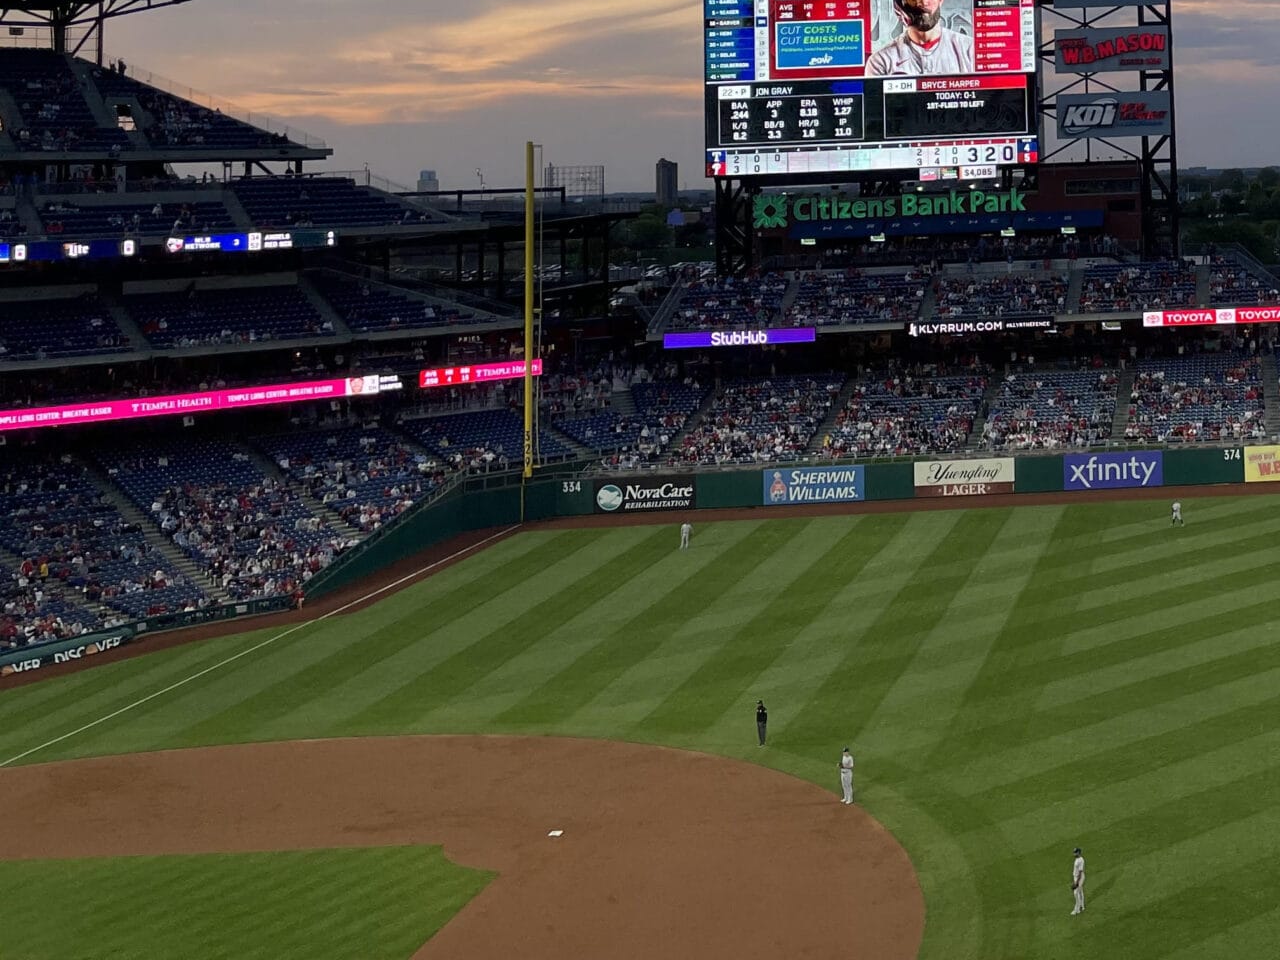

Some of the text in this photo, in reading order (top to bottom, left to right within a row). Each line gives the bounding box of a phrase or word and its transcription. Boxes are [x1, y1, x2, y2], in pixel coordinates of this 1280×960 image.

[780, 25, 837, 35] CUT COSTS
[780, 35, 860, 45] CUT EMISSIONS
[1062, 33, 1166, 65] W.B.MASON
[887, 81, 913, 90] 3 DH
[922, 79, 980, 90] BRYCE HARPER
[722, 89, 733, 97] 22
[756, 86, 793, 97] JON GRAY
[935, 91, 976, 100] TODAY: 0-1
[731, 98, 853, 110] BAA APP ERA WHIP
[959, 101, 968, 109] TO
[968, 100, 984, 108] LEFT
[730, 111, 749, 119] .244
[771, 110, 778, 118] 3
[834, 107, 852, 116] 1.27
[732, 122, 747, 130] K/9
[764, 120, 784, 129] BB/9
[839, 118, 847, 126] IP
[767, 131, 782, 139] 3.3
[834, 128, 852, 137] 11.0
[968, 146, 1014, 162] 3 2 0
[964, 168, 993, 177] $4,085
[793, 187, 1027, 221] Citizens Bank Park
[185, 242, 221, 250] NETWORK
[1165, 312, 1213, 323] TOYOTA
[919, 321, 1003, 334] KLYRRUM.COM
[711, 331, 768, 346] StubHub
[483, 367, 510, 376] TEMPLE
[141, 397, 211, 411] TEMPLE HEALTH
[18, 413, 34, 423] LUNG
[62, 409, 89, 419] BREATHE
[90, 407, 112, 417] EASIER
[1224, 448, 1241, 461] 374
[789, 469, 856, 485] SHERWIN
[927, 462, 1002, 483] Yuengling
[1070, 455, 1157, 488] xfinity
[562, 481, 581, 493] 334
[624, 483, 693, 500] NovaCare
[943, 483, 987, 496] LAGER
[624, 500, 690, 509] REHABILITATION
